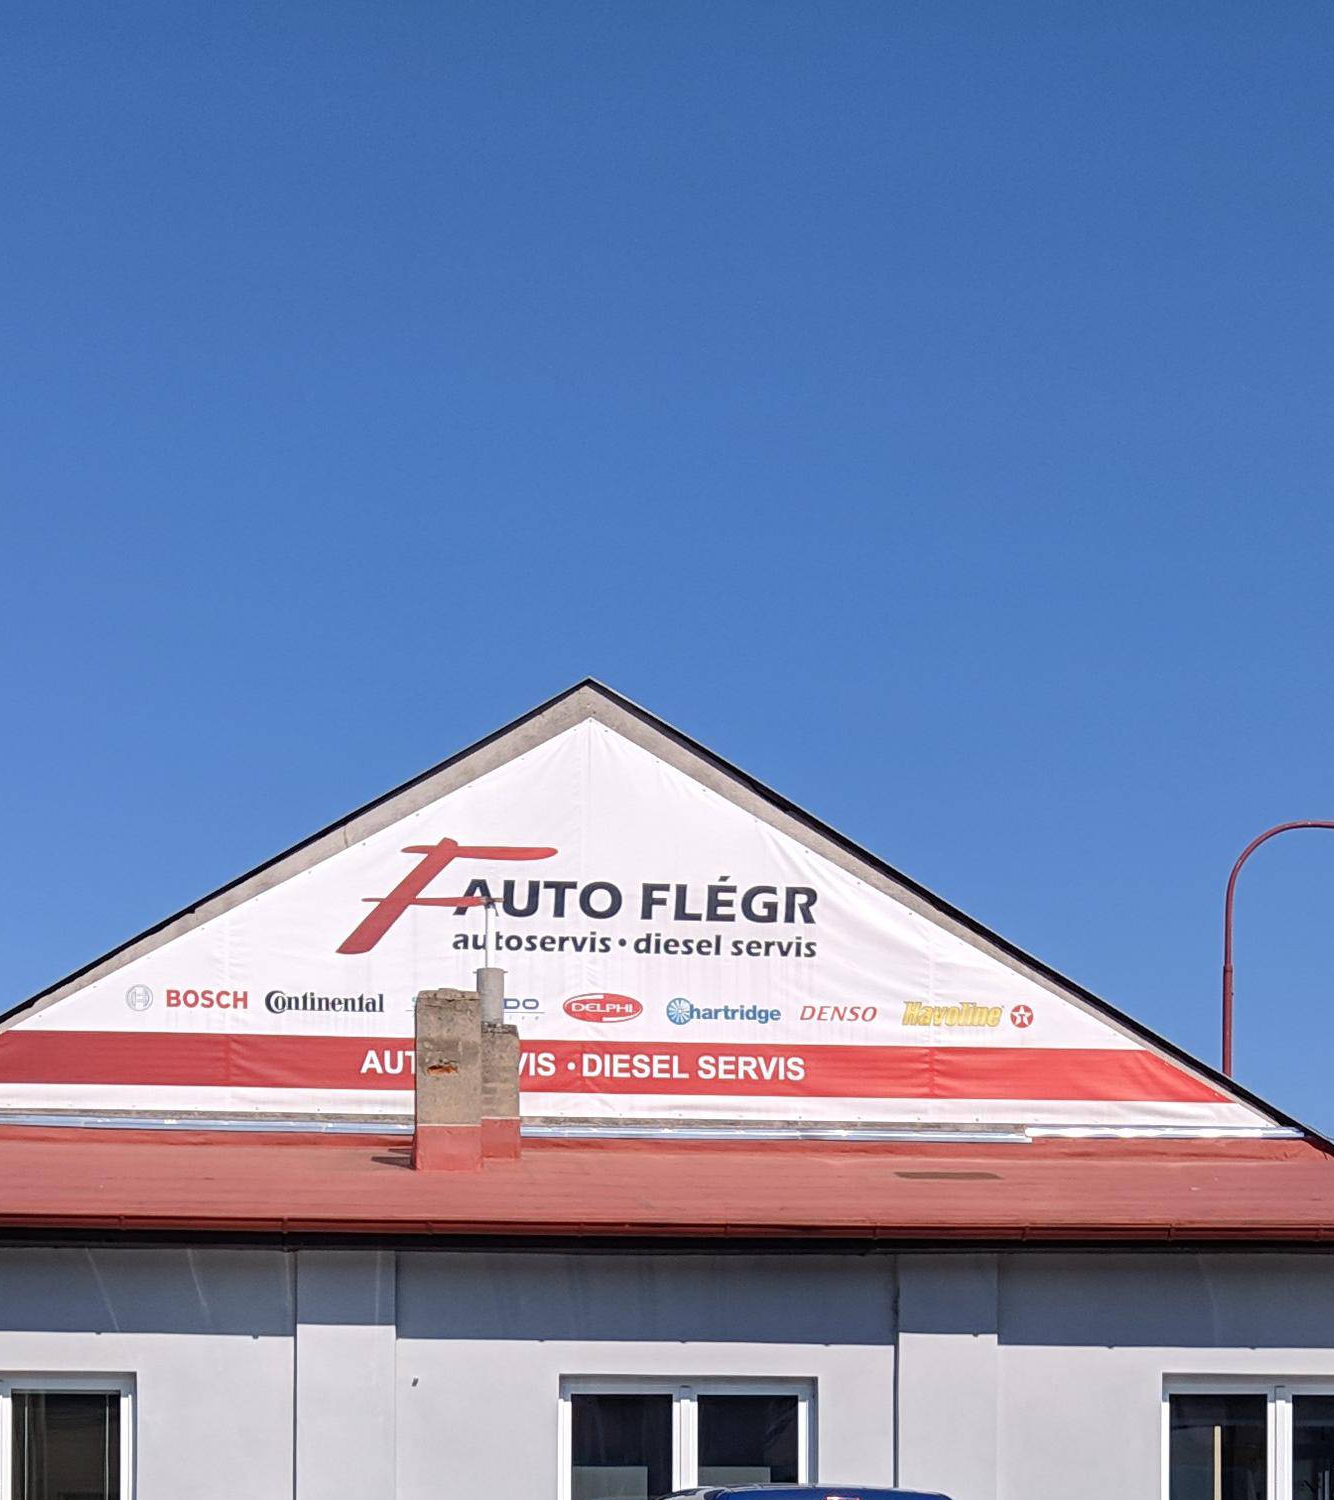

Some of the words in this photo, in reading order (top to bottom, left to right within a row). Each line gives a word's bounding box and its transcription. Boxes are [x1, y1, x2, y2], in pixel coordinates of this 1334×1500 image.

[452, 879, 623, 919] AUTO
[640, 876, 819, 924] FLÉGR
[451, 933, 611, 954] autoservis
[634, 933, 721, 957] diesel
[730, 937, 817, 959] servis
[166, 989, 248, 1009] BOSCH
[265, 990, 385, 1014] Continental
[570, 1001, 633, 1014] DELPHI
[689, 1004, 782, 1024] hartridge
[800, 1005, 878, 1022] DENSO
[901, 1001, 1004, 1027] Havoline
[581, 1053, 689, 1080] DIESEL
[696, 1054, 805, 1081] SERVIS
